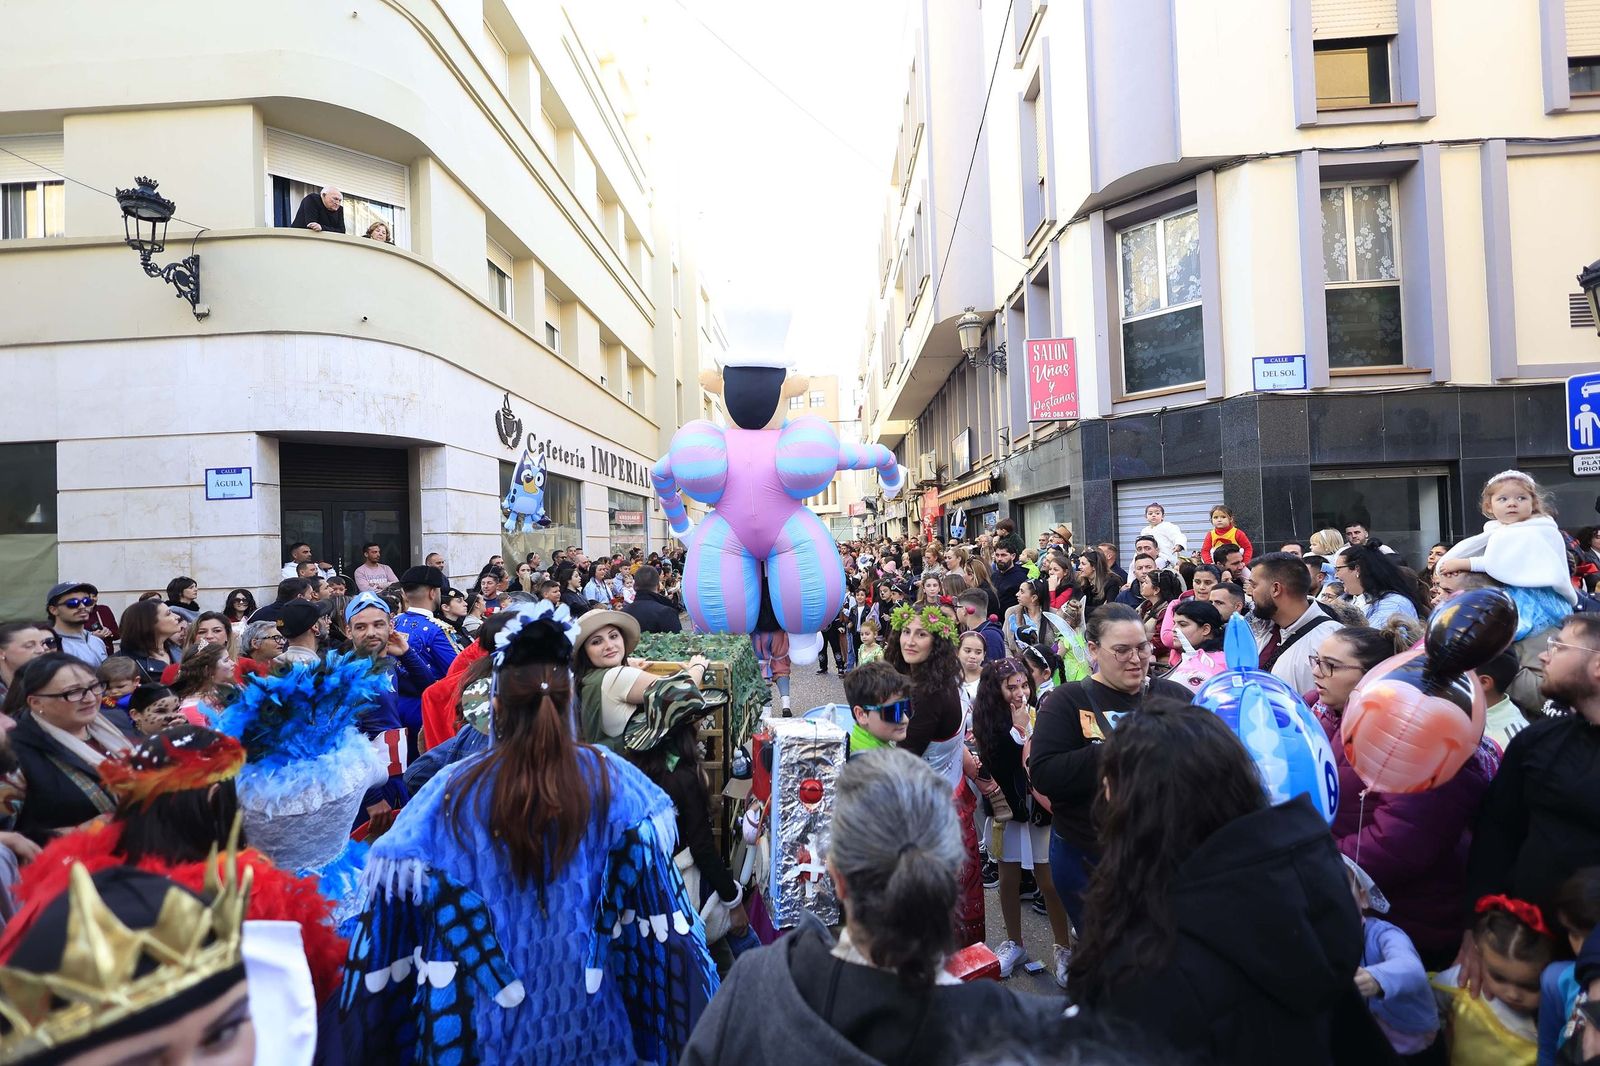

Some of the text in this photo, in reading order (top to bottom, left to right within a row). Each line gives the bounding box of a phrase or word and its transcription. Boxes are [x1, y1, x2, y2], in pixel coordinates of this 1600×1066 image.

[1032, 363, 1071, 383] Uñas
[1262, 369, 1296, 378] DEL SOL
[1048, 381, 1055, 393] y
[1033, 391, 1077, 416] Pestañas
[527, 432, 650, 489] Cafetería IMPERIAL
[214, 479, 243, 488] ÁGUILA
